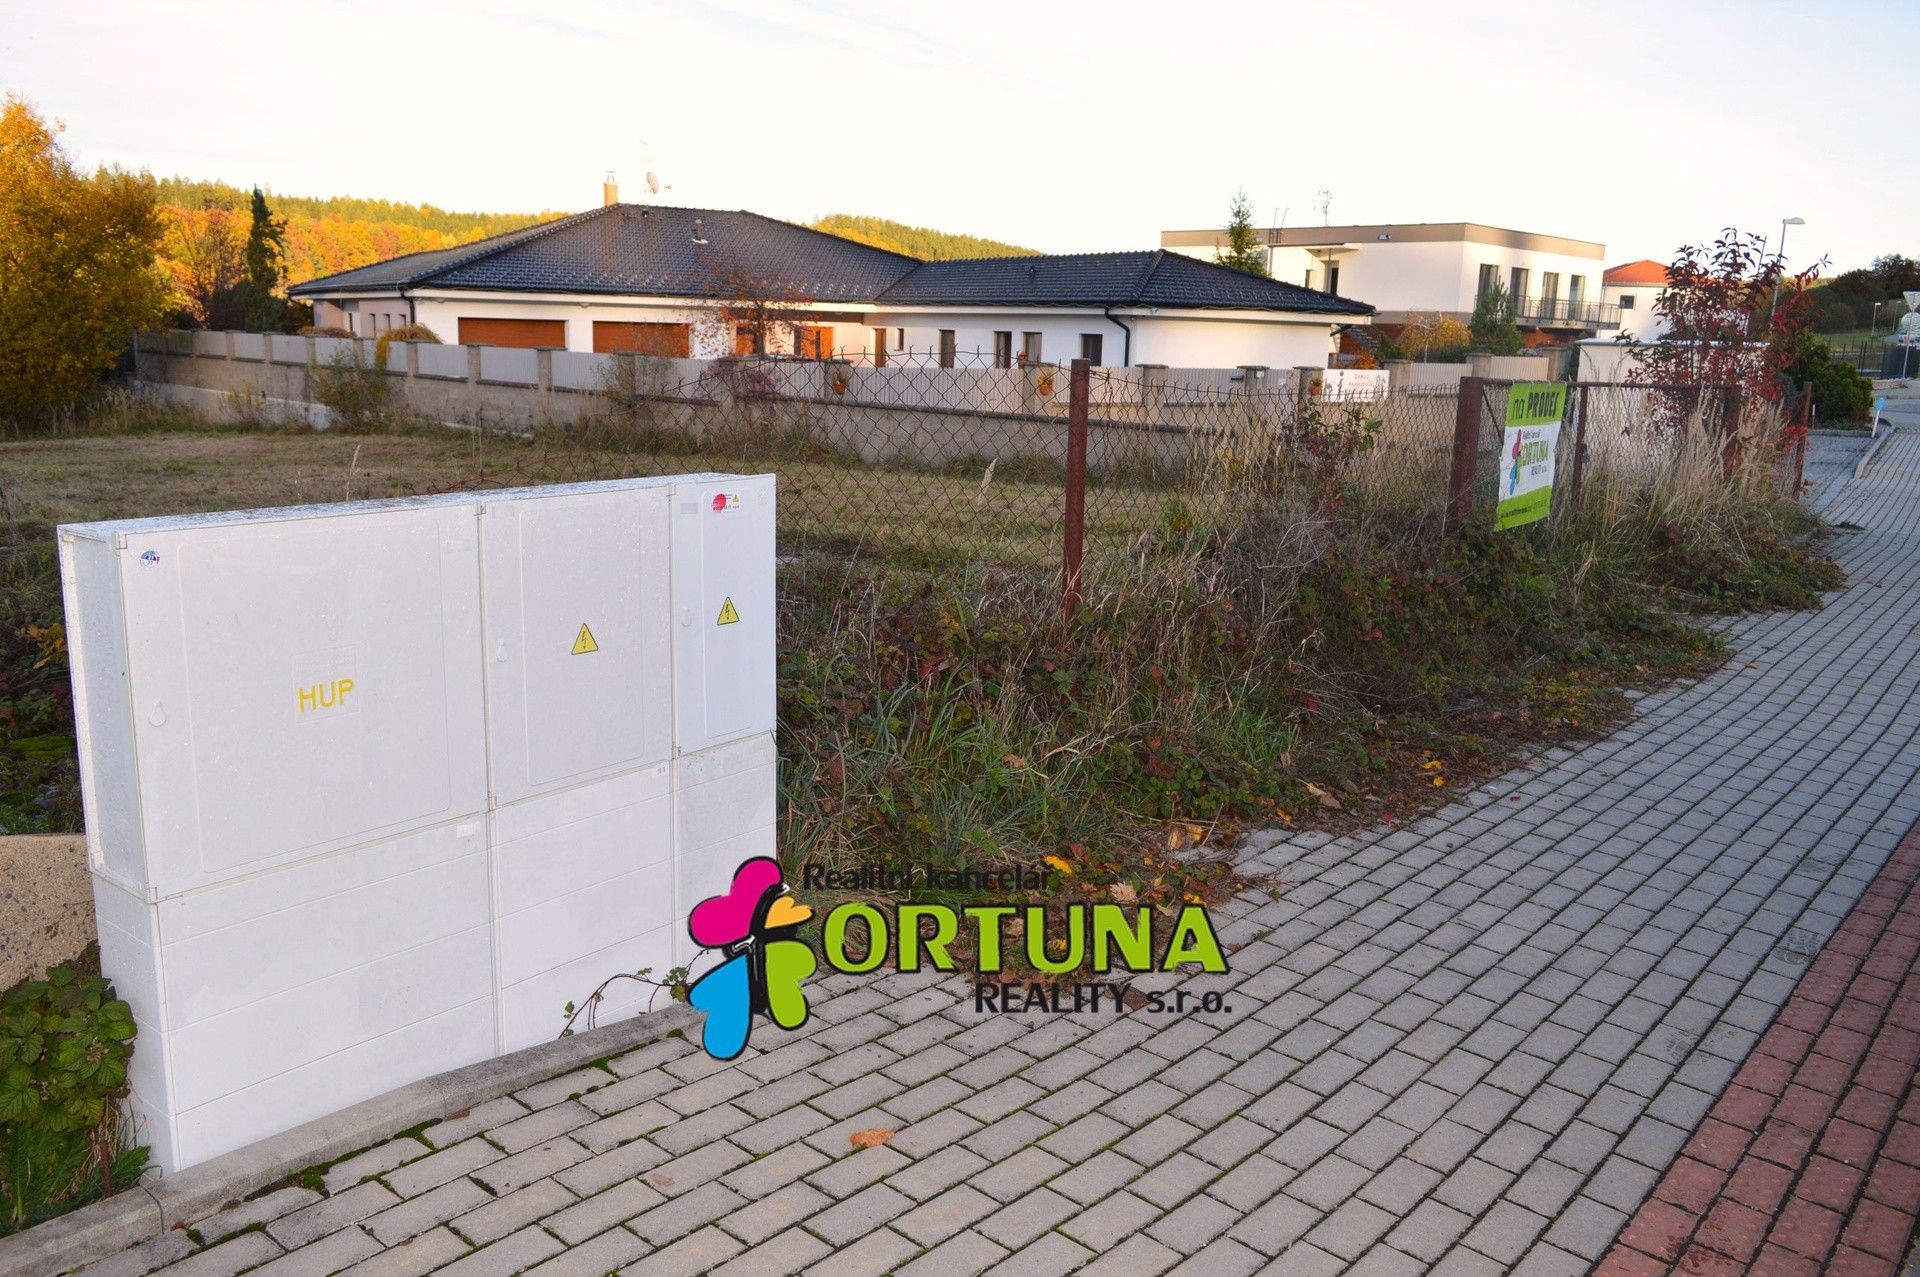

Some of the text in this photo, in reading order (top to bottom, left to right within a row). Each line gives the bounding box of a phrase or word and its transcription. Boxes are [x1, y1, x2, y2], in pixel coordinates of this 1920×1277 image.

[1512, 391, 1560, 419] na PRODEJ
[298, 678, 353, 712] HUP
